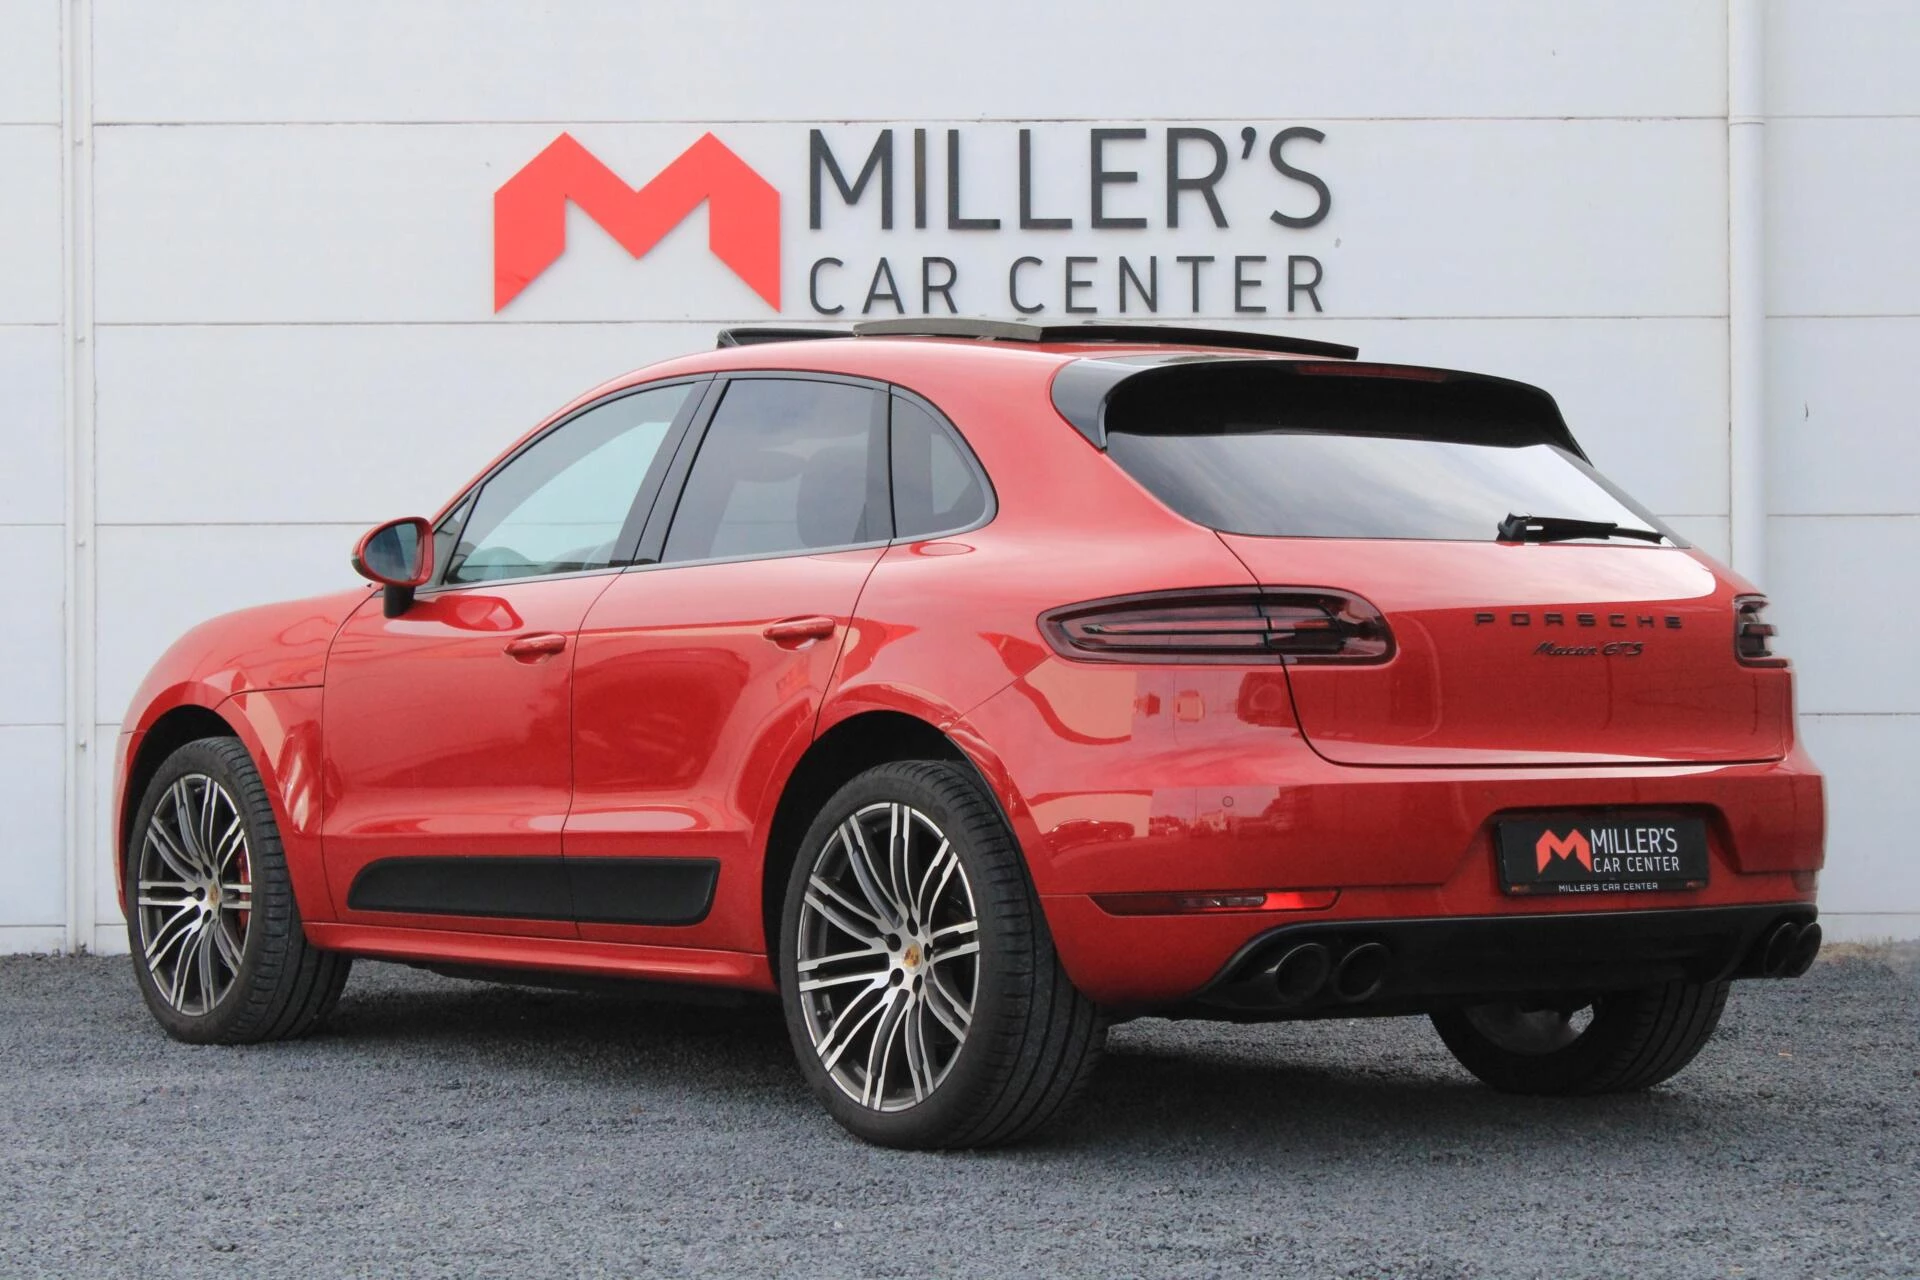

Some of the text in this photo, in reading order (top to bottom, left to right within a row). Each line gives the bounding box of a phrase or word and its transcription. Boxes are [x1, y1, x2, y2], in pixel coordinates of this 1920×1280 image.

[809, 126, 1332, 231] MILLER'S
[808, 254, 1325, 315] CAR CENTER
[1474, 611, 1683, 629] PORSCHE
[1602, 641, 1645, 656] GTS
[1590, 827, 1678, 854] MILLER'S
[1593, 856, 1680, 873] CAR CENTER
[1558, 881, 1658, 892] MILLER'S CAR CENTER
